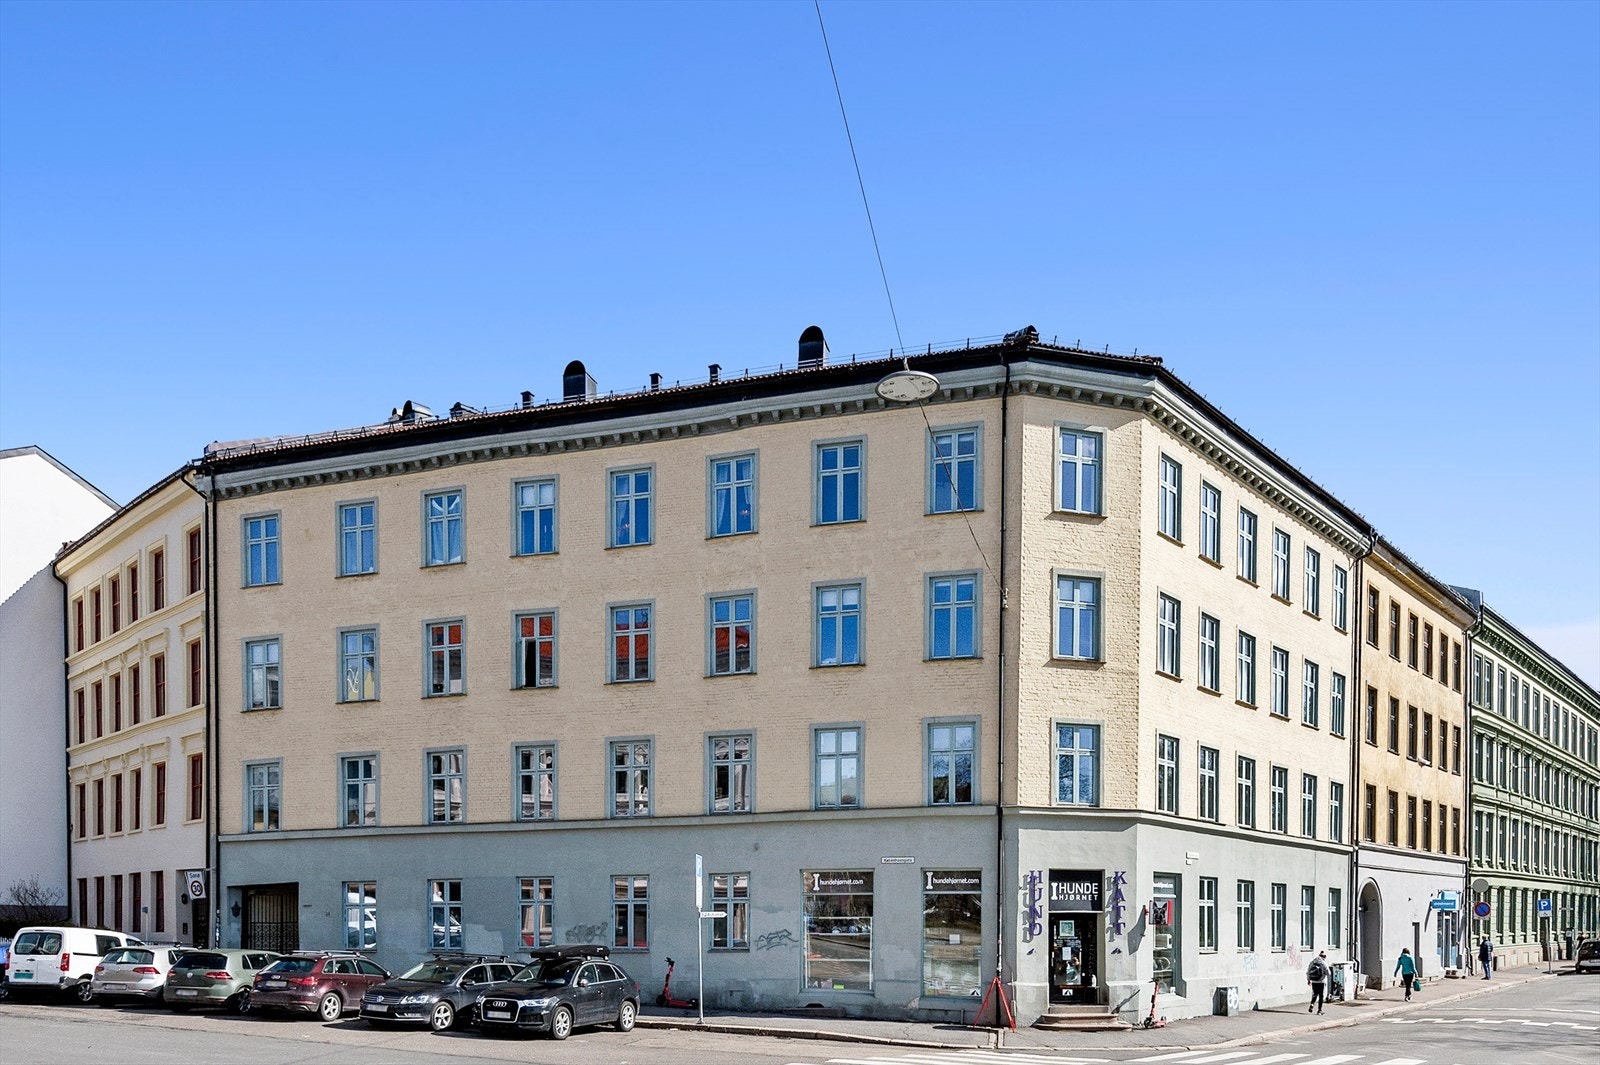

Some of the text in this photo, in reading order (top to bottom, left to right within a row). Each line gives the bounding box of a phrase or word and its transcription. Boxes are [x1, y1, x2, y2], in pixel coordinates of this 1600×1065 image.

[193, 884, 201, 893] 30
[1058, 882, 1098, 894] HUNDE
[1029, 870, 1043, 936] HUND
[1113, 871, 1127, 936] KATT
[1540, 900, 1549, 910] P
